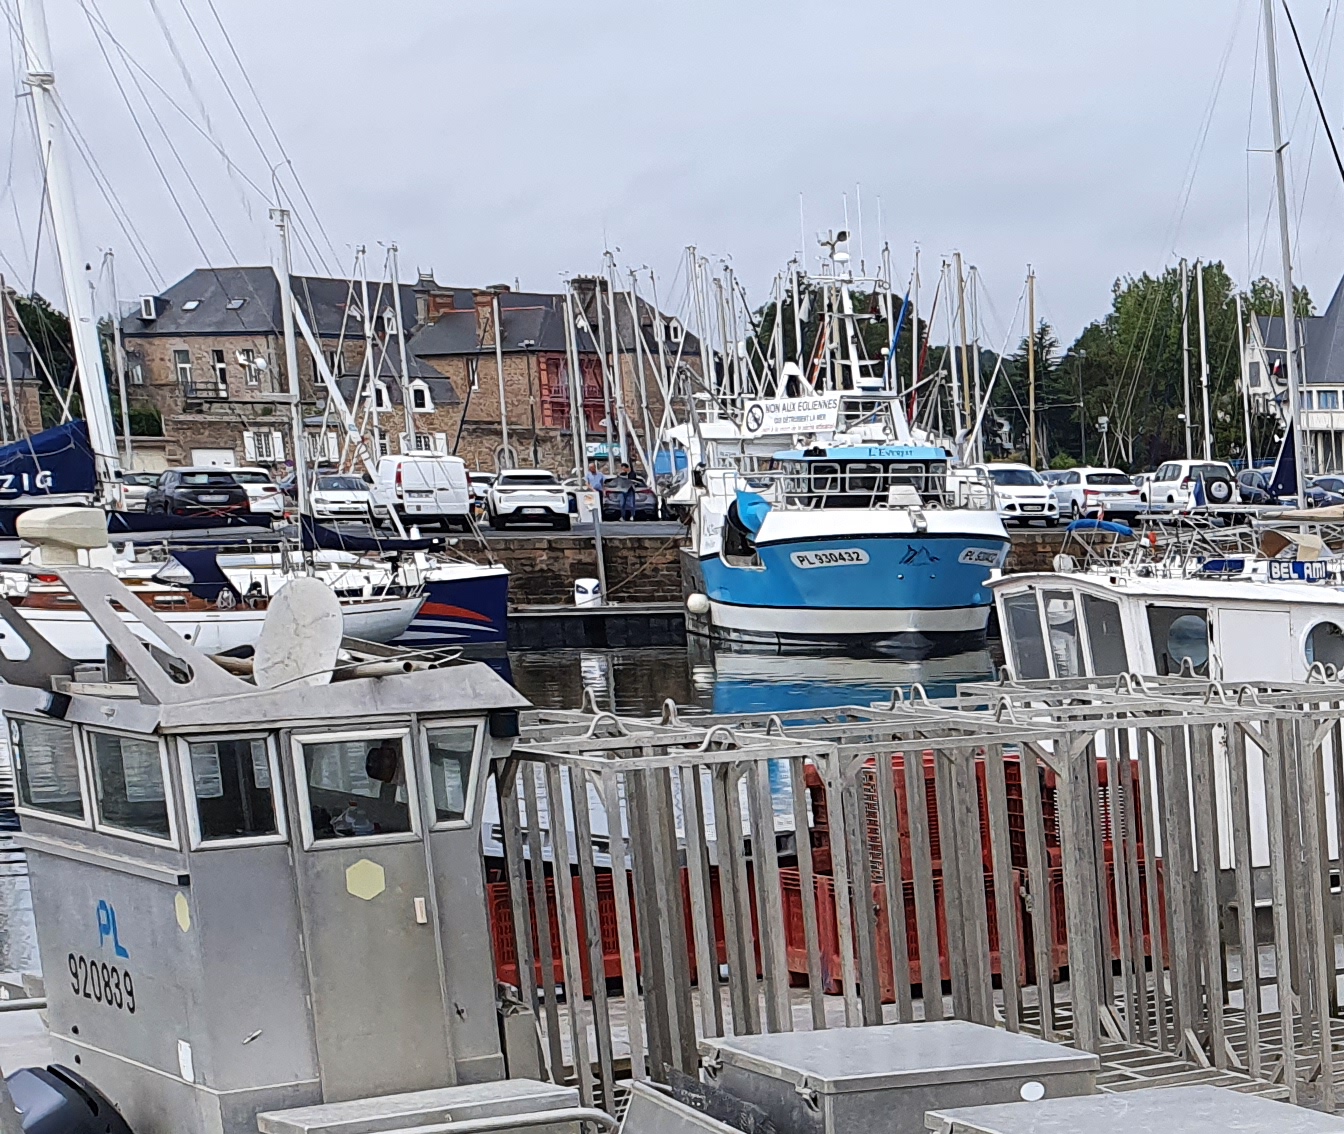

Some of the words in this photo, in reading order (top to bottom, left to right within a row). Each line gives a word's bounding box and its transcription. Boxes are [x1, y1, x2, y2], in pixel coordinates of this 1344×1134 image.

[1271, 562, 1299, 579] BEL
[1304, 562, 1326, 580] AMI
[96, 899, 130, 960] PL
[68, 952, 136, 1014] 920839
